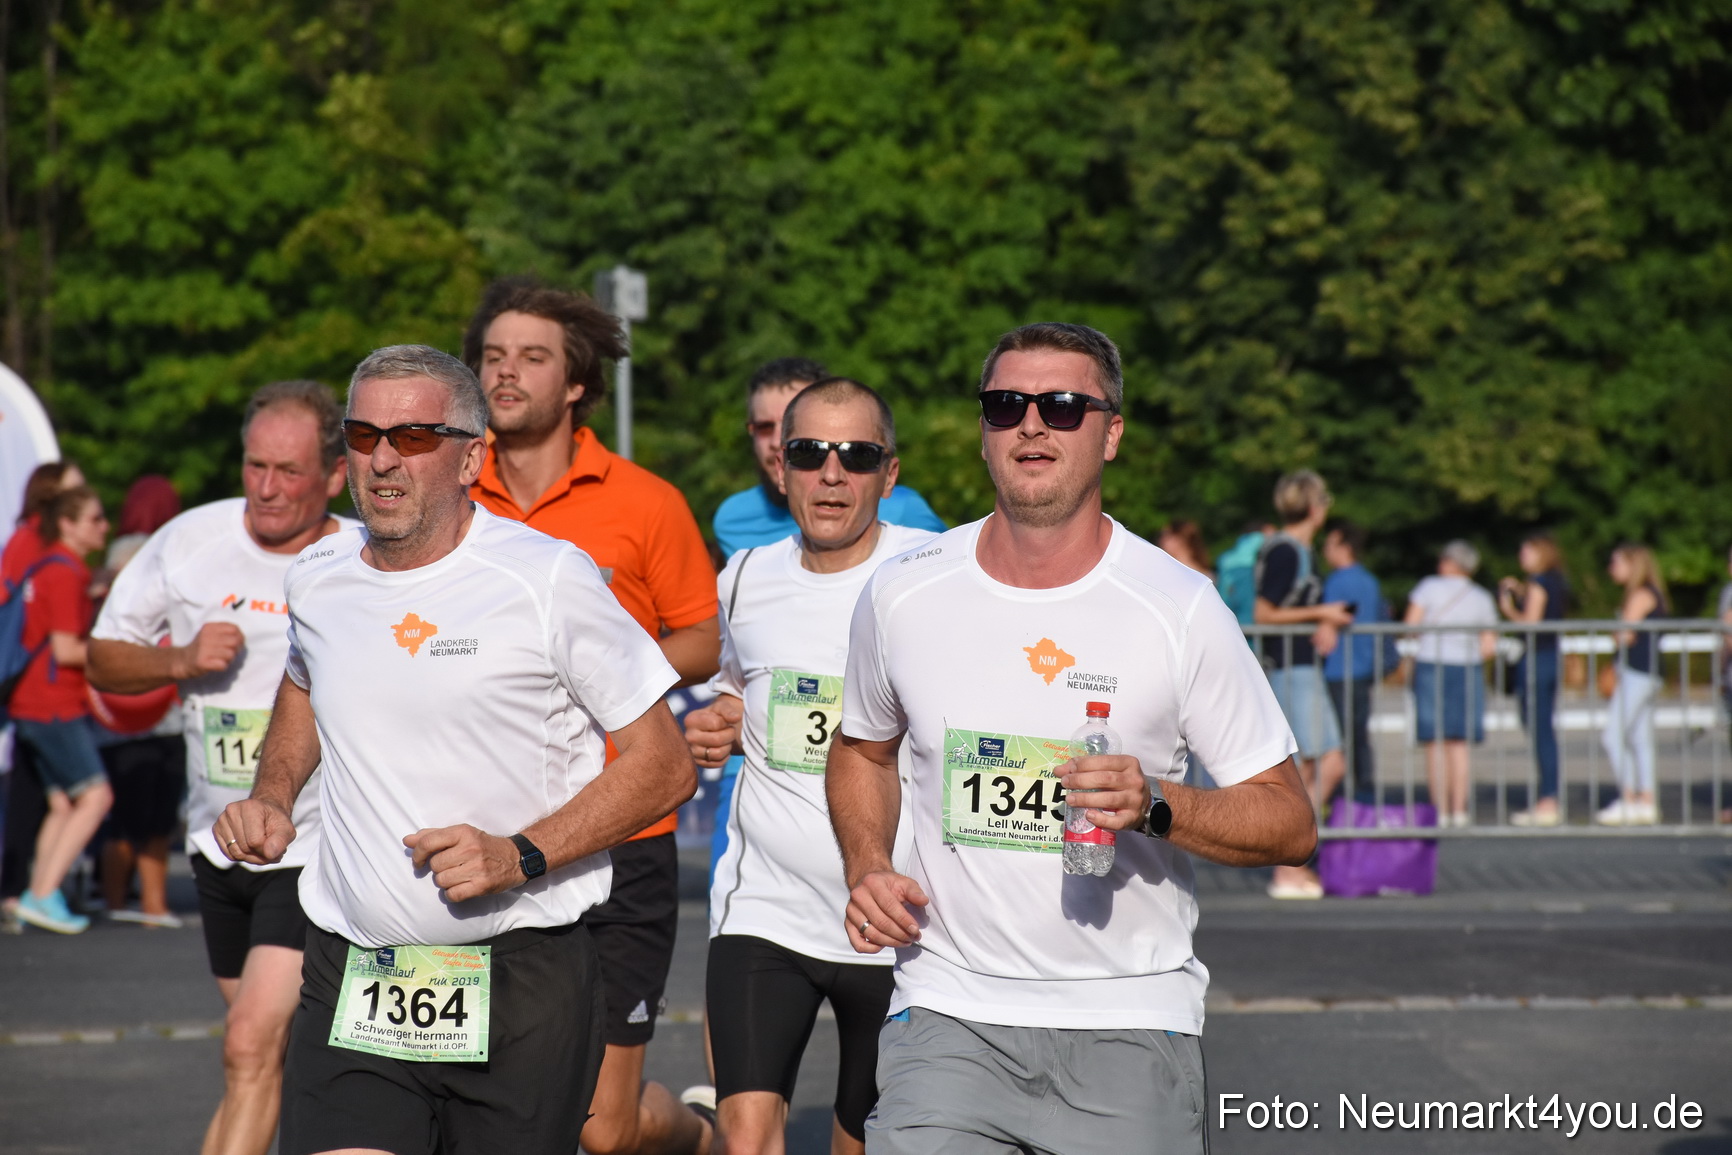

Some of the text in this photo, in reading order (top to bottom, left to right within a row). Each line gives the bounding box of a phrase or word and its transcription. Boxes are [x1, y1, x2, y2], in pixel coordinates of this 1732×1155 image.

[308, 549, 335, 561] JAKO
[914, 547, 942, 560] JAKO
[403, 628, 421, 639] NM
[430, 638, 478, 648] LANDKREIS
[429, 647, 478, 657] NEUMARKT
[1038, 654, 1057, 666] NM
[1067, 671, 1118, 685] LANDKREIS
[1066, 680, 1118, 694] NEUMARKT
[787, 690, 837, 705] firmenlauf
[966, 752, 1027, 769] firmenlauf
[987, 817, 1050, 833] Lell Walter
[959, 826, 1007, 839] Landratsamt
[1008, 831, 1047, 842] Neumarkt
[368, 961, 416, 978] firmenlauf
[451, 976, 480, 986] 2019
[362, 981, 468, 1029] 1364
[354, 1021, 468, 1041] Schweiger Hermann
[350, 1032, 400, 1047] Landratsamt
[401, 1041, 437, 1050] Neumarkt
